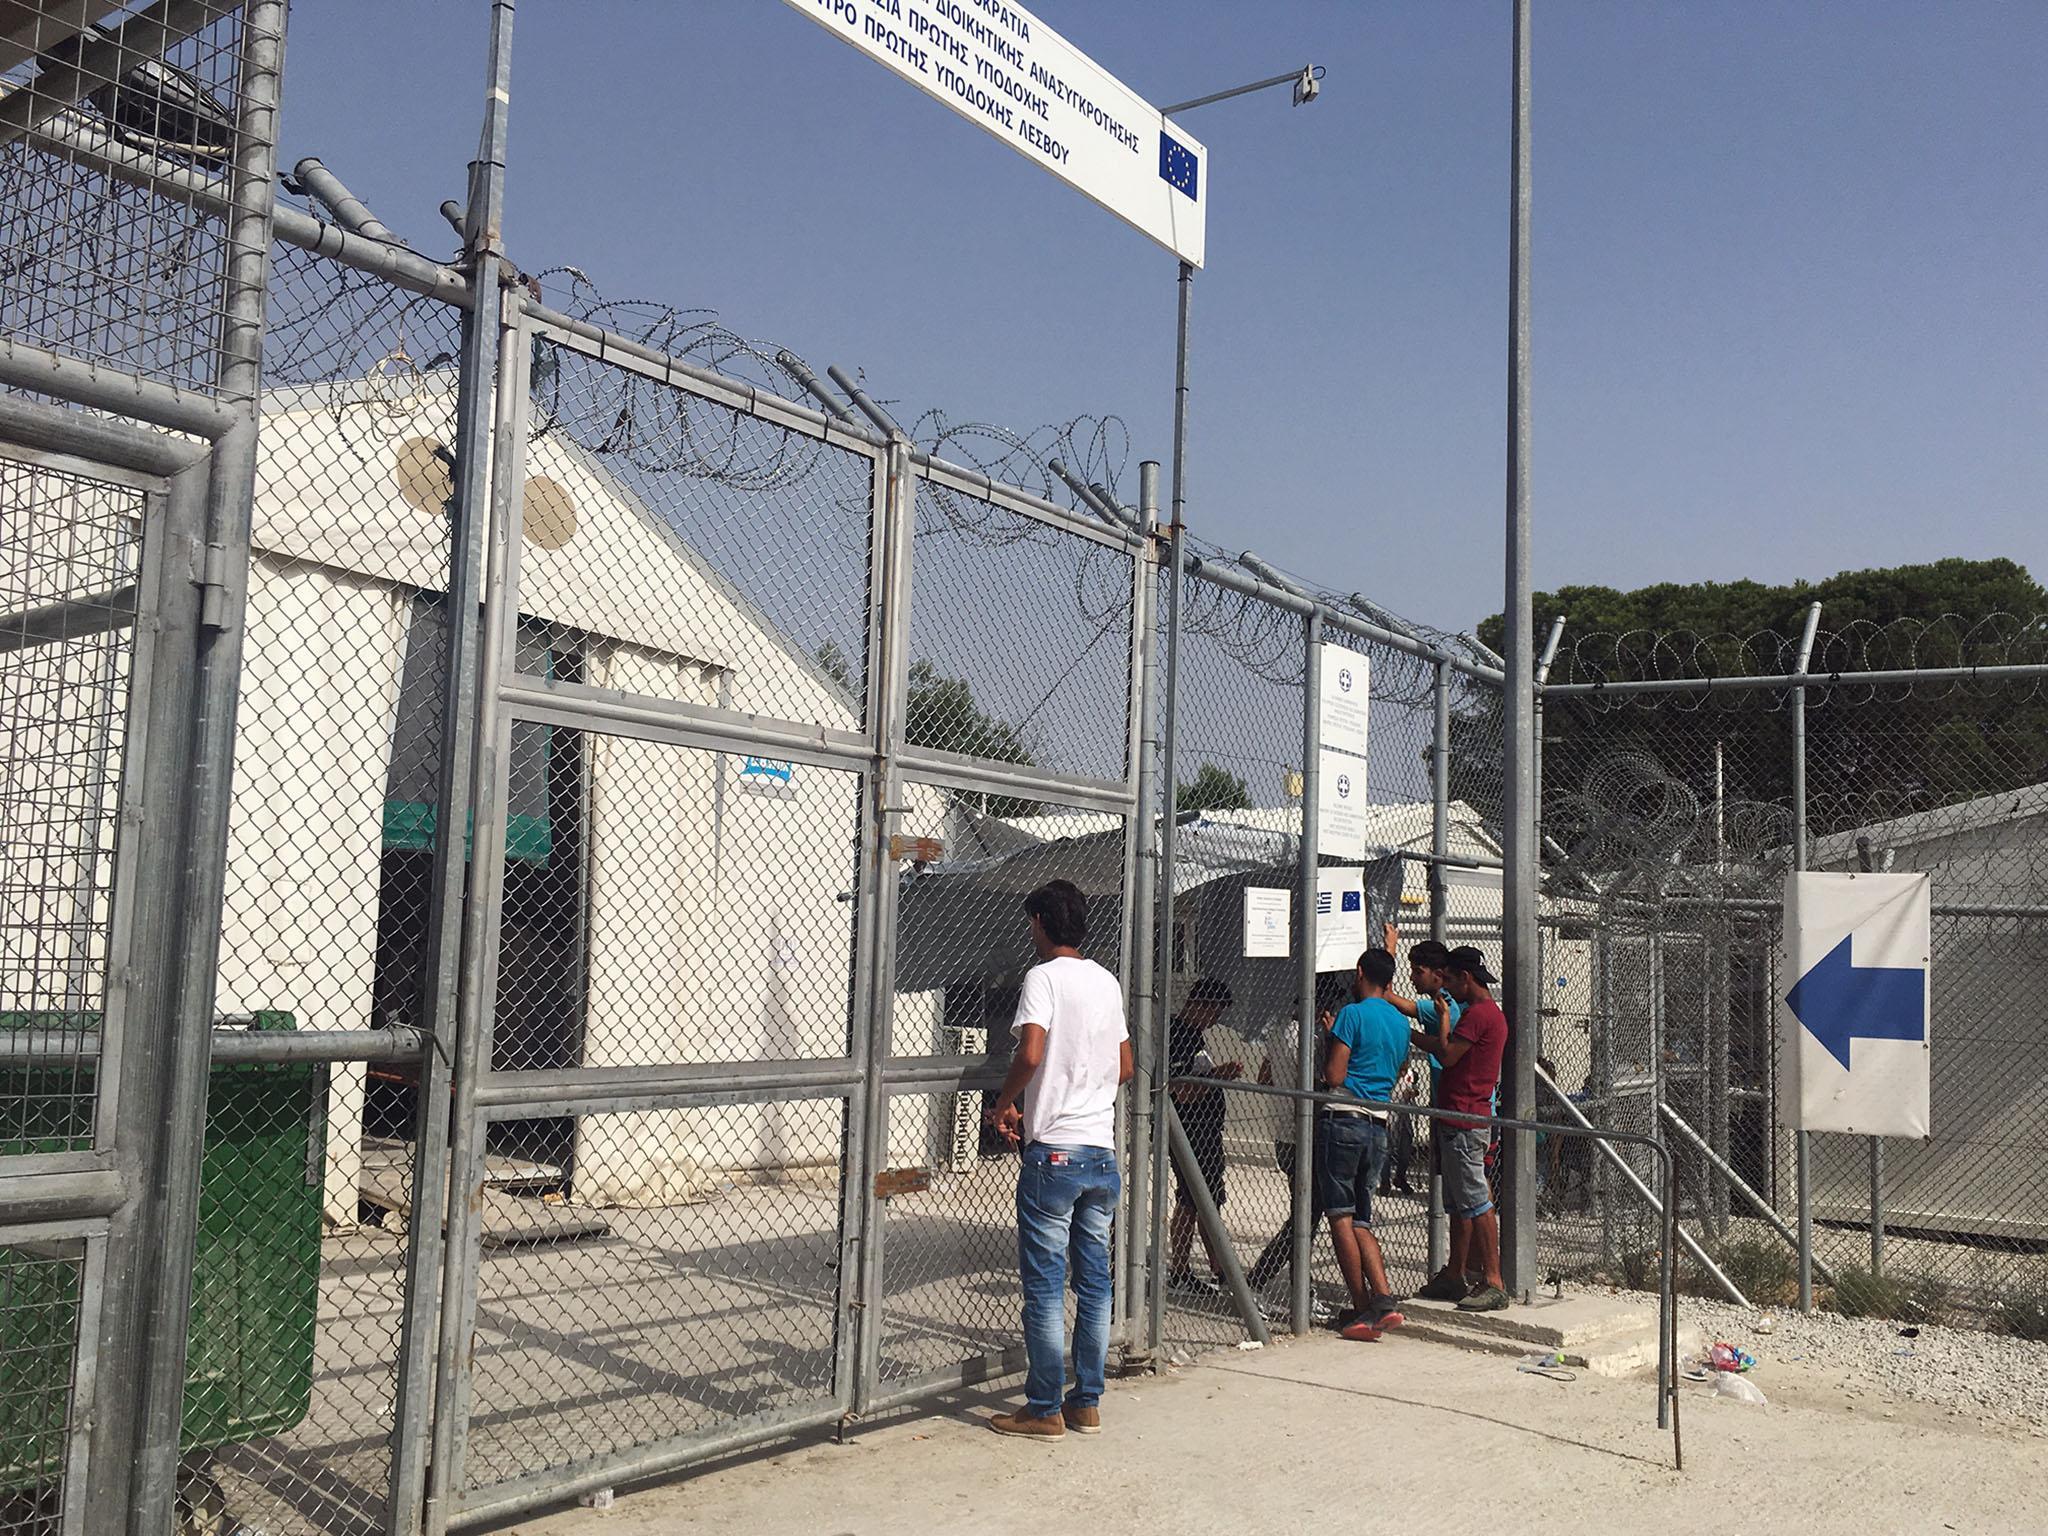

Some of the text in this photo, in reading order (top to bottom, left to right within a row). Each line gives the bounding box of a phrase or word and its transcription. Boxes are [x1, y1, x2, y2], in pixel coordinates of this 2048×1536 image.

[865, 15, 928, 74] ΠΡΩΤΗΣ
[935, 61, 1014, 130] ΥΠΟΔΟΧΗΣ
[1019, 120, 1070, 165] ΛΕΣΒΟΥ
[908, 8, 969, 66] ΠΡΩΤΗΣ
[974, 54, 1050, 121] ΥΠΟΔΟΧΗΣ
[936, 0, 1140, 154] ΔΙΟΙΚΗΤΙΚΗΣ ΑΝΑΣΥΓΚΡΟΤΗΣΗΣ
